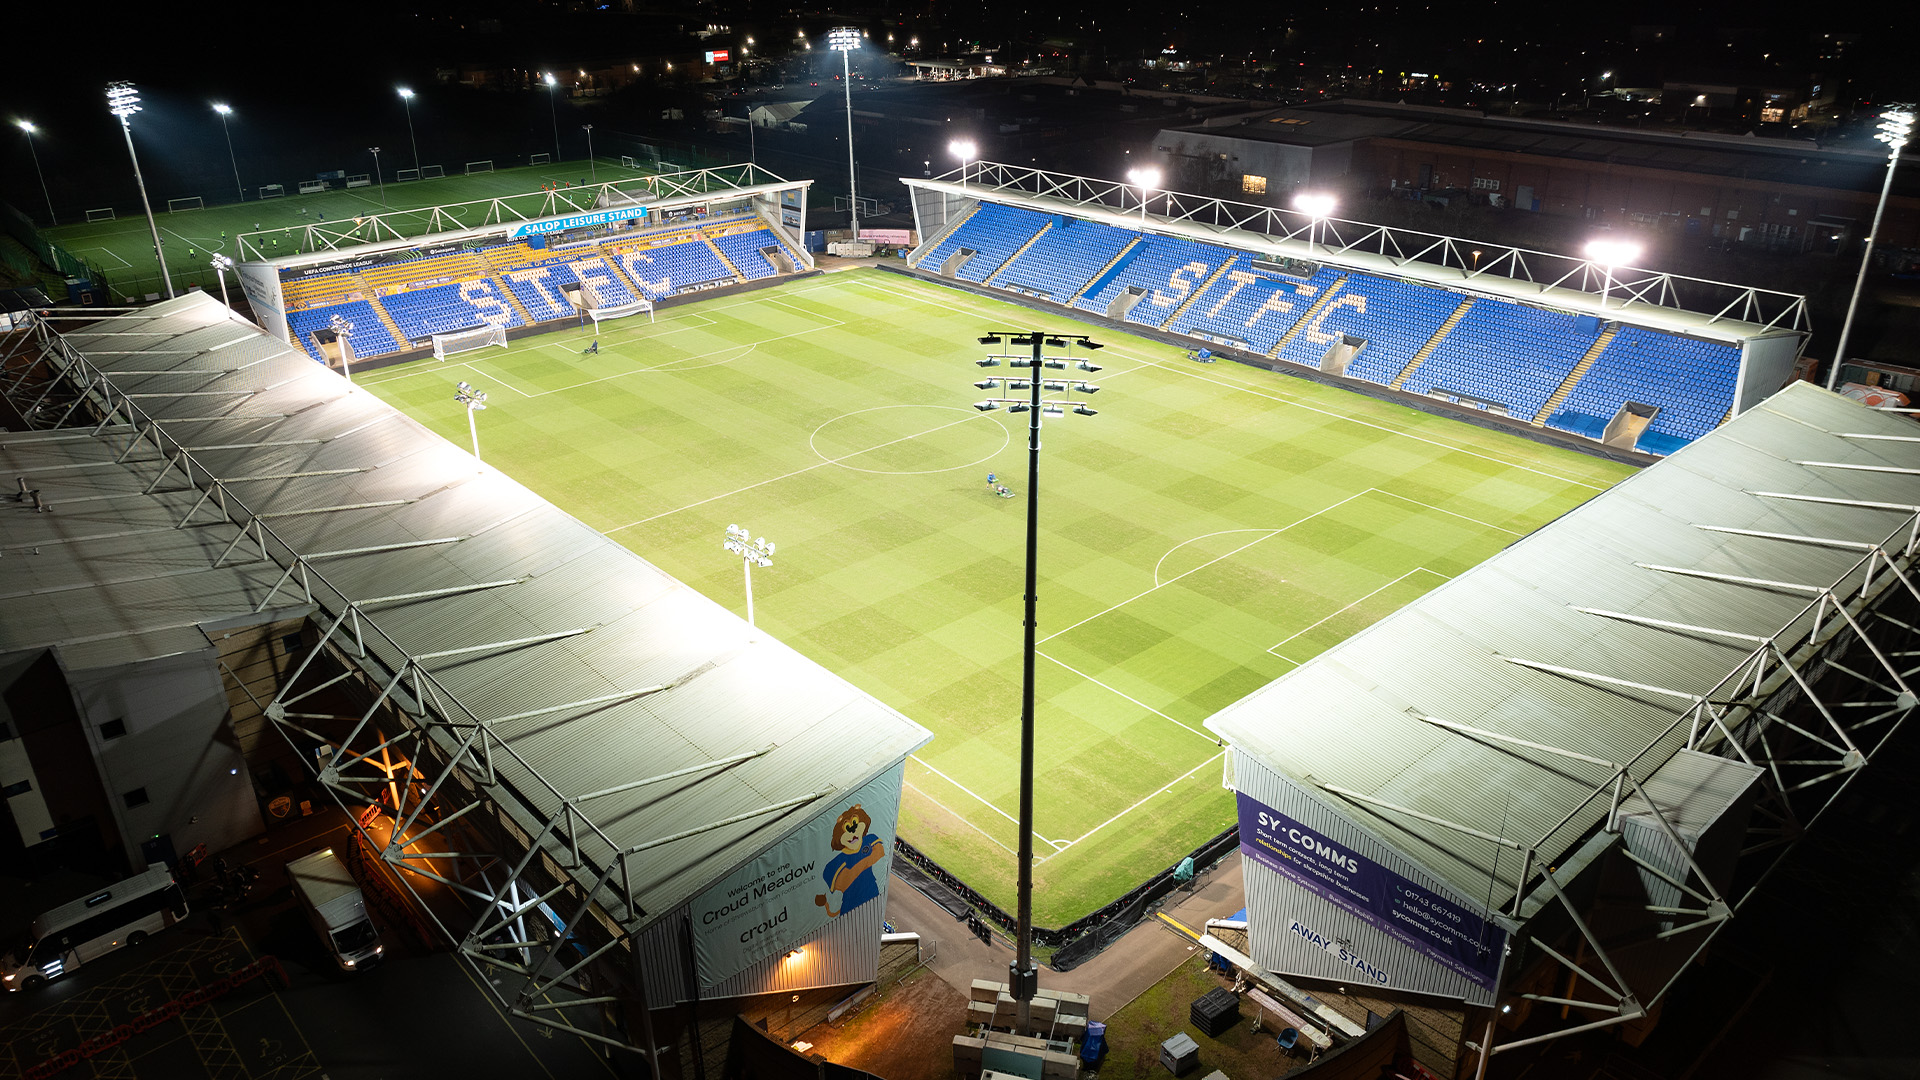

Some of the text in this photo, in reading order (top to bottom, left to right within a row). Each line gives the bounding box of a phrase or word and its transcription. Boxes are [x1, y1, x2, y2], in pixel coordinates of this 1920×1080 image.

[525, 208, 642, 234] SALOP LEISURE STAND
[319, 263, 353, 273] CONFERENCE
[353, 260, 373, 268] LEAGUE
[512, 261, 533, 270] PRIDE
[534, 258, 543, 266] OF
[545, 257, 558, 265] ALL
[1255, 837, 1370, 903] relationships for shropshire businesses
[1255, 853, 1319, 892] Business Phone Systems
[1256, 828, 1349, 882] Short term contracts, long term
[702, 860, 816, 926] Croud Meadow
[727, 861, 791, 899] Welcome to the
[739, 906, 788, 943] croud
[1328, 893, 1374, 923] Business Mobile
[1405, 889, 1461, 924] 01743 667419
[704, 924, 723, 937] Home
[1384, 923, 1416, 946] IT Support
[1392, 909, 1453, 946] sycomms.co.uk
[1402, 901, 1491, 955] hello@sycomms.co.uk
[1291, 922, 1388, 984] AWAY STAND
[1426, 947, 1484, 984] Payment Solutions
